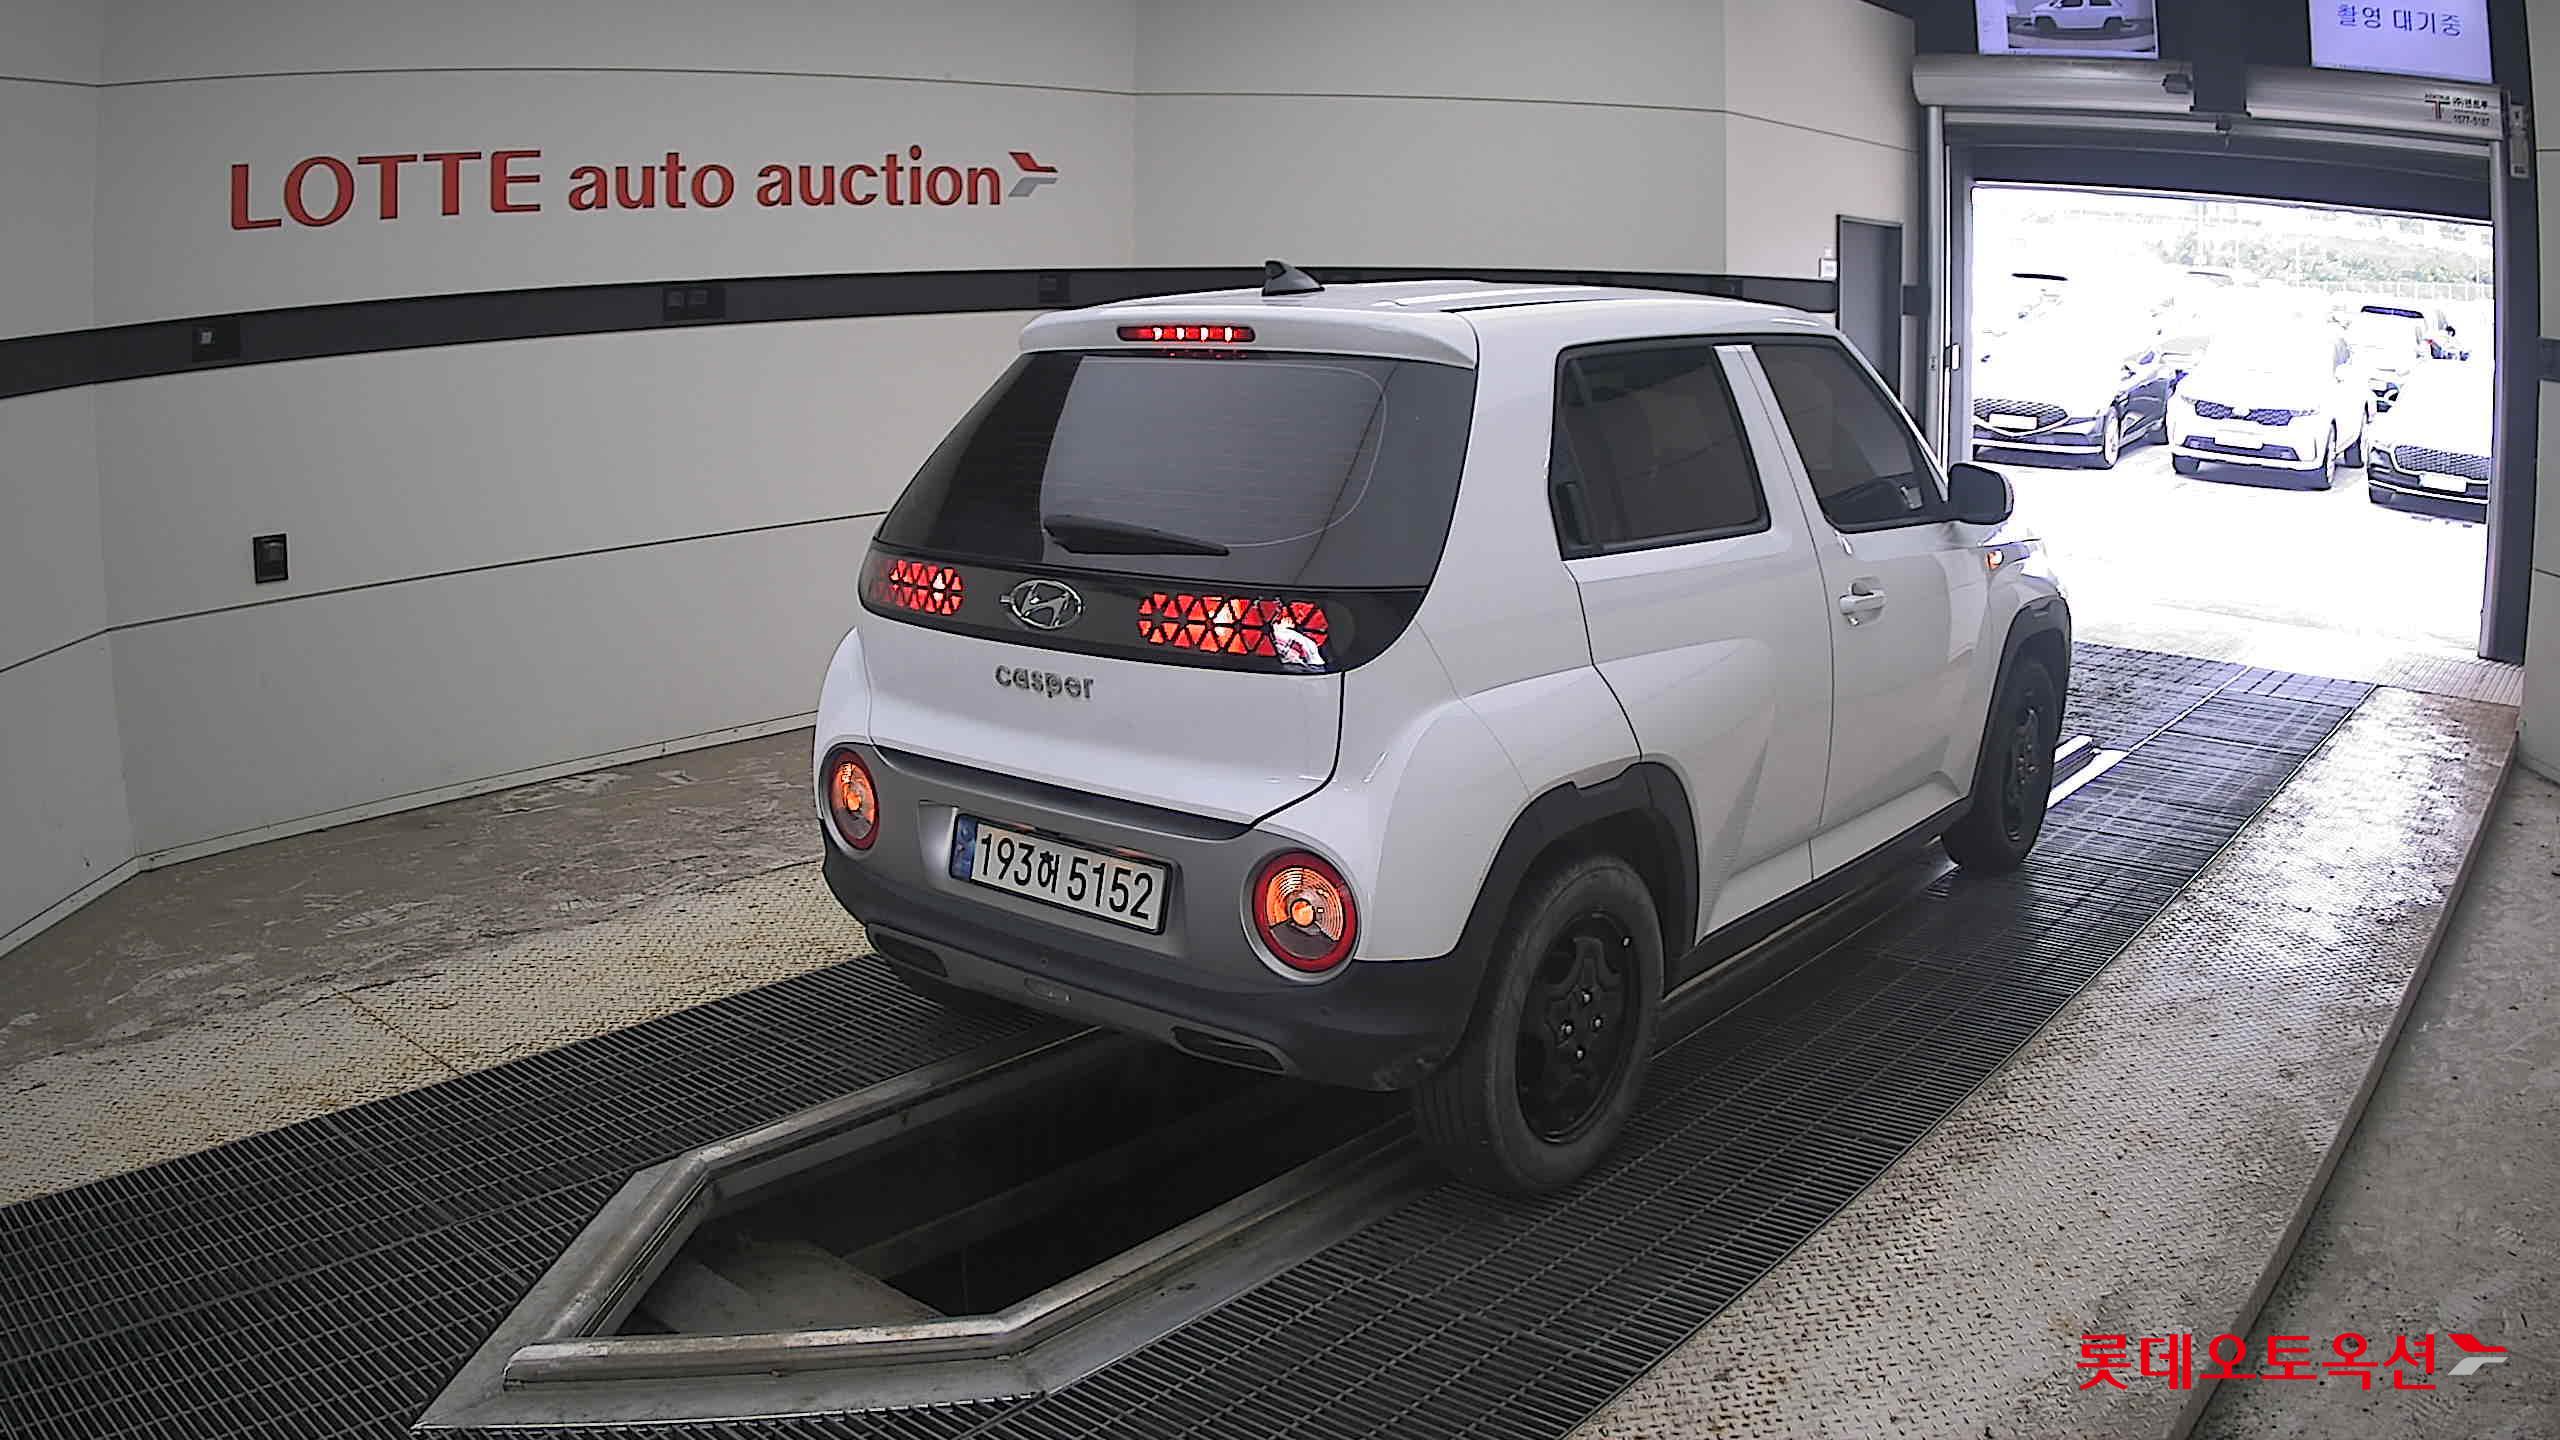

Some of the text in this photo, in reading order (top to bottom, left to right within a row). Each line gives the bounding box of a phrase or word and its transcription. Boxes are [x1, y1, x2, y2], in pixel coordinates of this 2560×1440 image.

[2337, 4, 2461, 37] 촬영 대기중
[231, 145, 1003, 231] LOTTE auto auction
[994, 664, 1095, 699] casper
